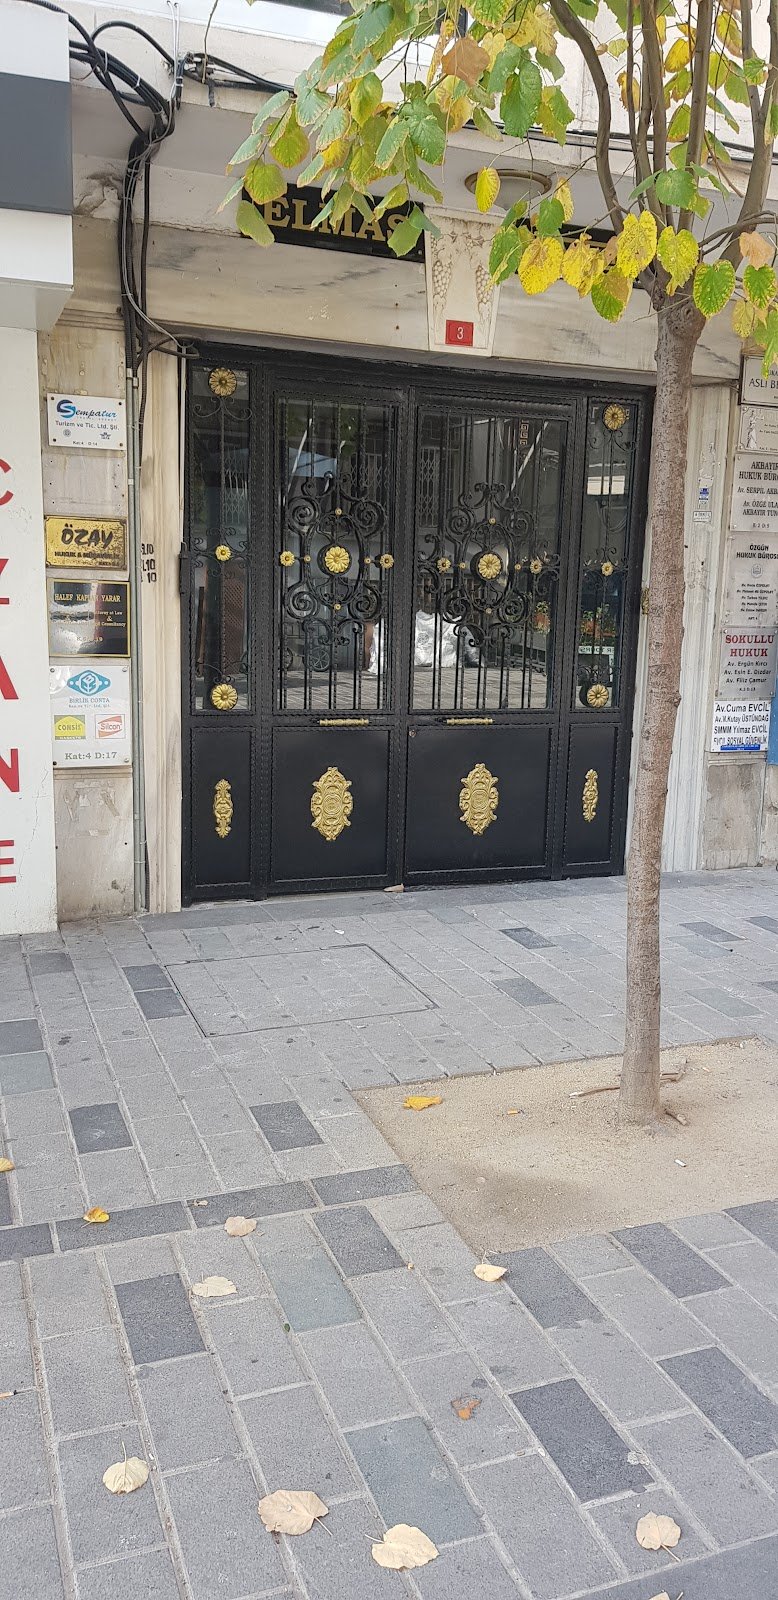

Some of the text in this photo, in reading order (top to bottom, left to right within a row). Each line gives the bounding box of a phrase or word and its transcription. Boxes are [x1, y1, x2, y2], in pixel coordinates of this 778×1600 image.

[457, 326, 464, 340] 3
[738, 471, 762, 480] HUKUK
[61, 523, 114, 549] ÖZAY
[750, 543, 769, 551] ÖZGÜN
[725, 634, 774, 644] SOKULLU
[730, 648, 769, 657] HUKUK
[748, 702, 770, 712] EVCİL
[752, 723, 768, 734] EVCİL
[95, 752, 117, 760] D:17
